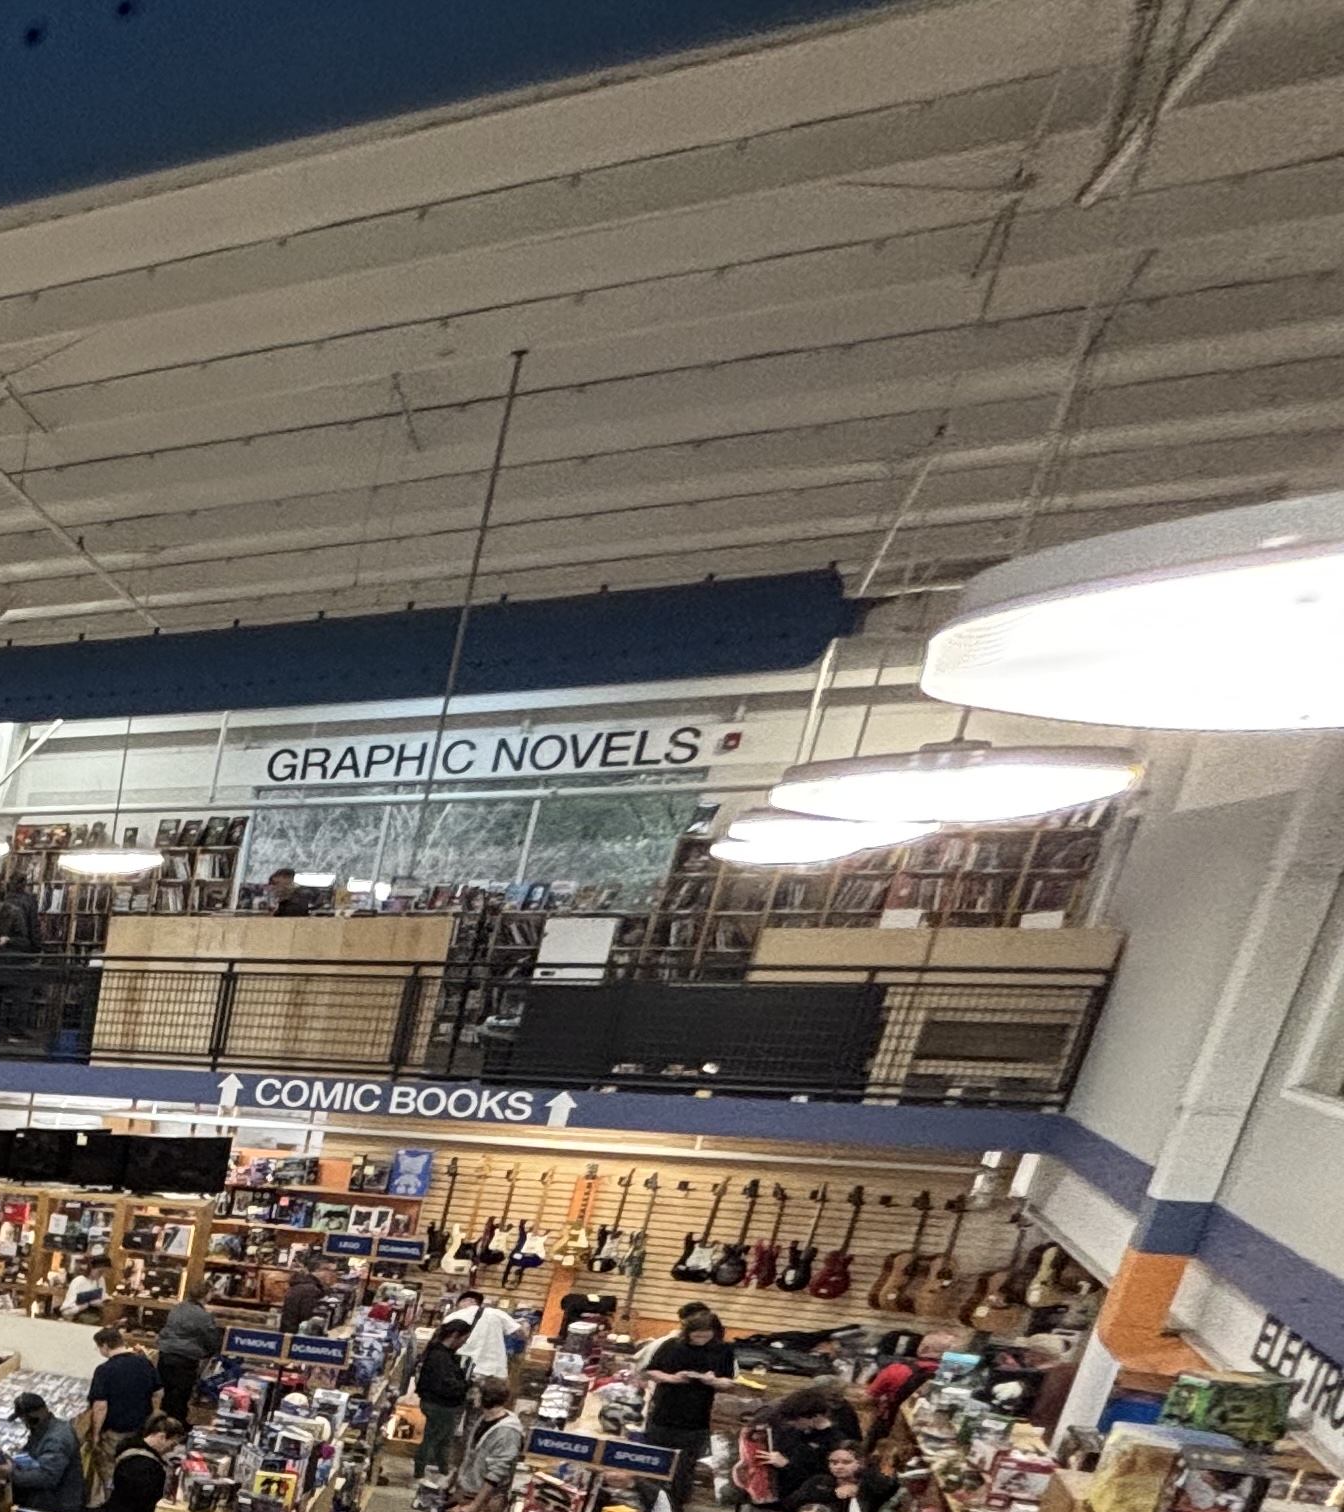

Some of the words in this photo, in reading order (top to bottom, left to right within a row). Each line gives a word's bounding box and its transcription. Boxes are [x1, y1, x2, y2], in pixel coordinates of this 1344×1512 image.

[267, 738, 478, 783] GRAPHC
[492, 725, 702, 773] NOVELS
[254, 1078, 385, 1116] COMIC
[389, 1086, 534, 1121] BOOKS
[537, 1438, 589, 1454] VEHICLES
[613, 1450, 661, 1466] SPORTS
